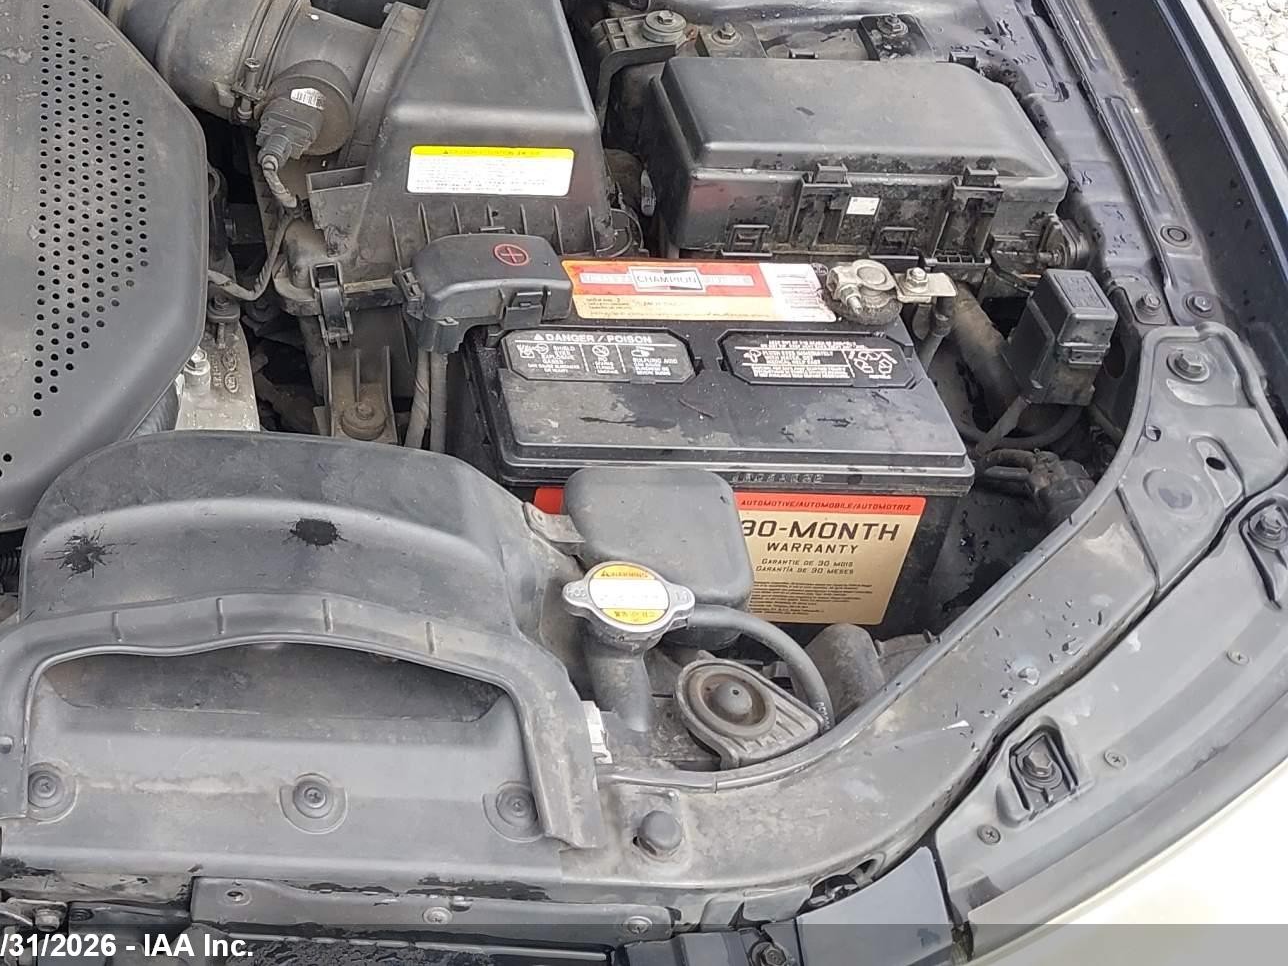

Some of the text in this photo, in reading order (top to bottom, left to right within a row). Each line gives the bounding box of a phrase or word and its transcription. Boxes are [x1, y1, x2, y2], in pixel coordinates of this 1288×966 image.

[636, 274, 697, 285] CHAMPION
[546, 334, 594, 342] DANGER
[608, 335, 652, 344] POISON
[741, 520, 900, 542] 30-MONTH
[766, 542, 858, 554] WARRANTY
